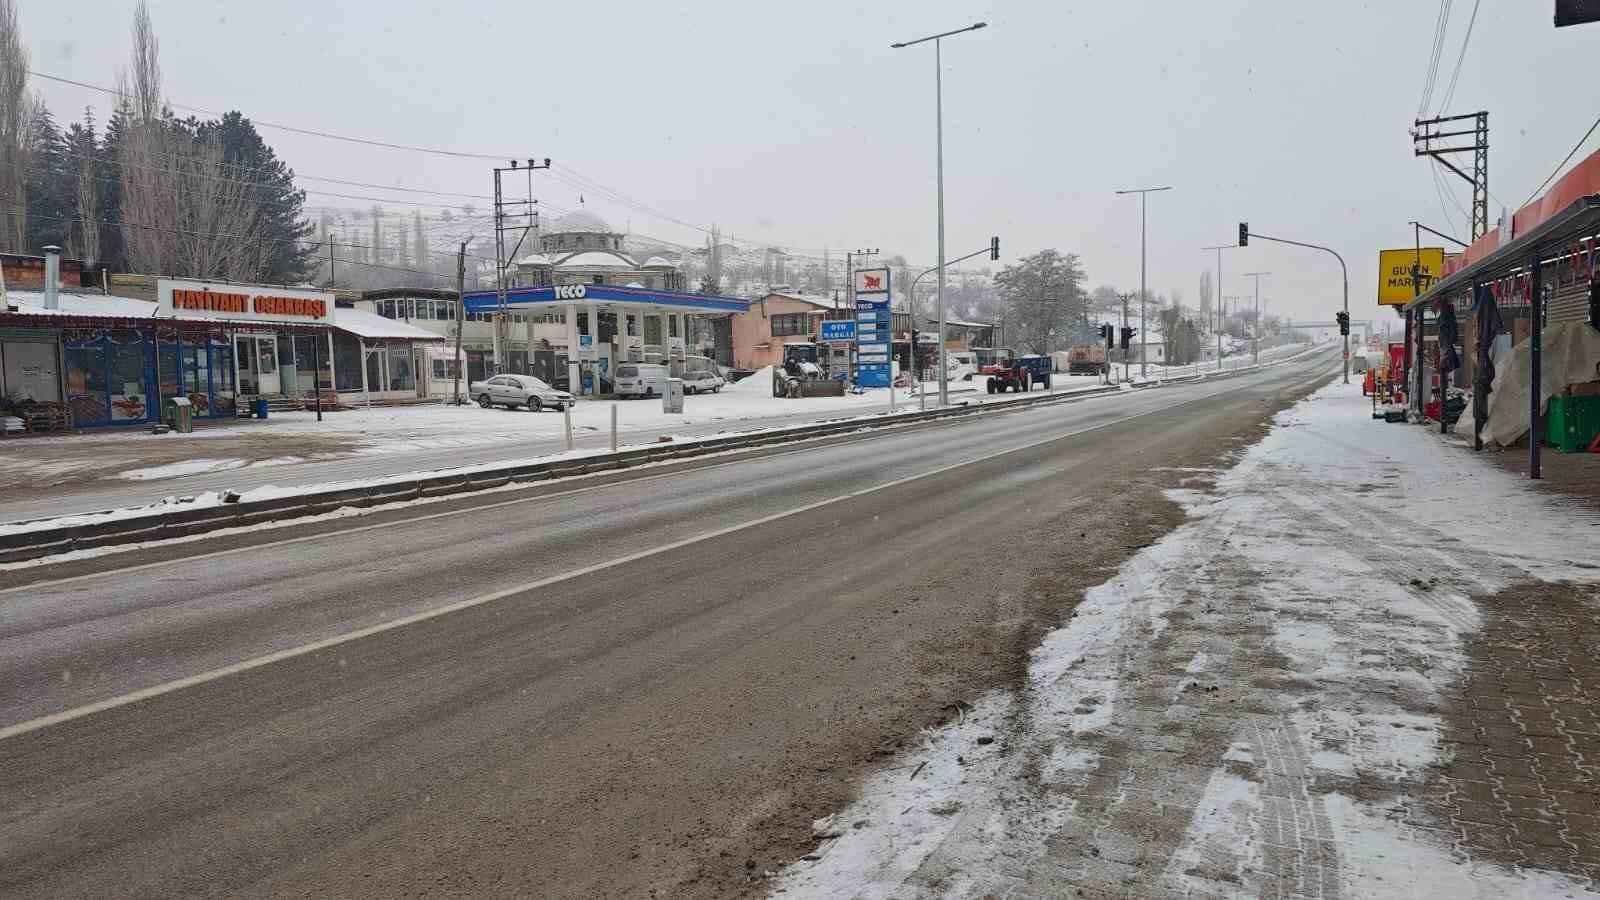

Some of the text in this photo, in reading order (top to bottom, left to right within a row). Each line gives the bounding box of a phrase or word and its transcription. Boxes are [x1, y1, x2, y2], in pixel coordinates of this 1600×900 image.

[1393, 264, 1429, 275] GÜVN
[554, 285, 586, 299] TECO
[172, 287, 250, 313] PAYİTAHT
